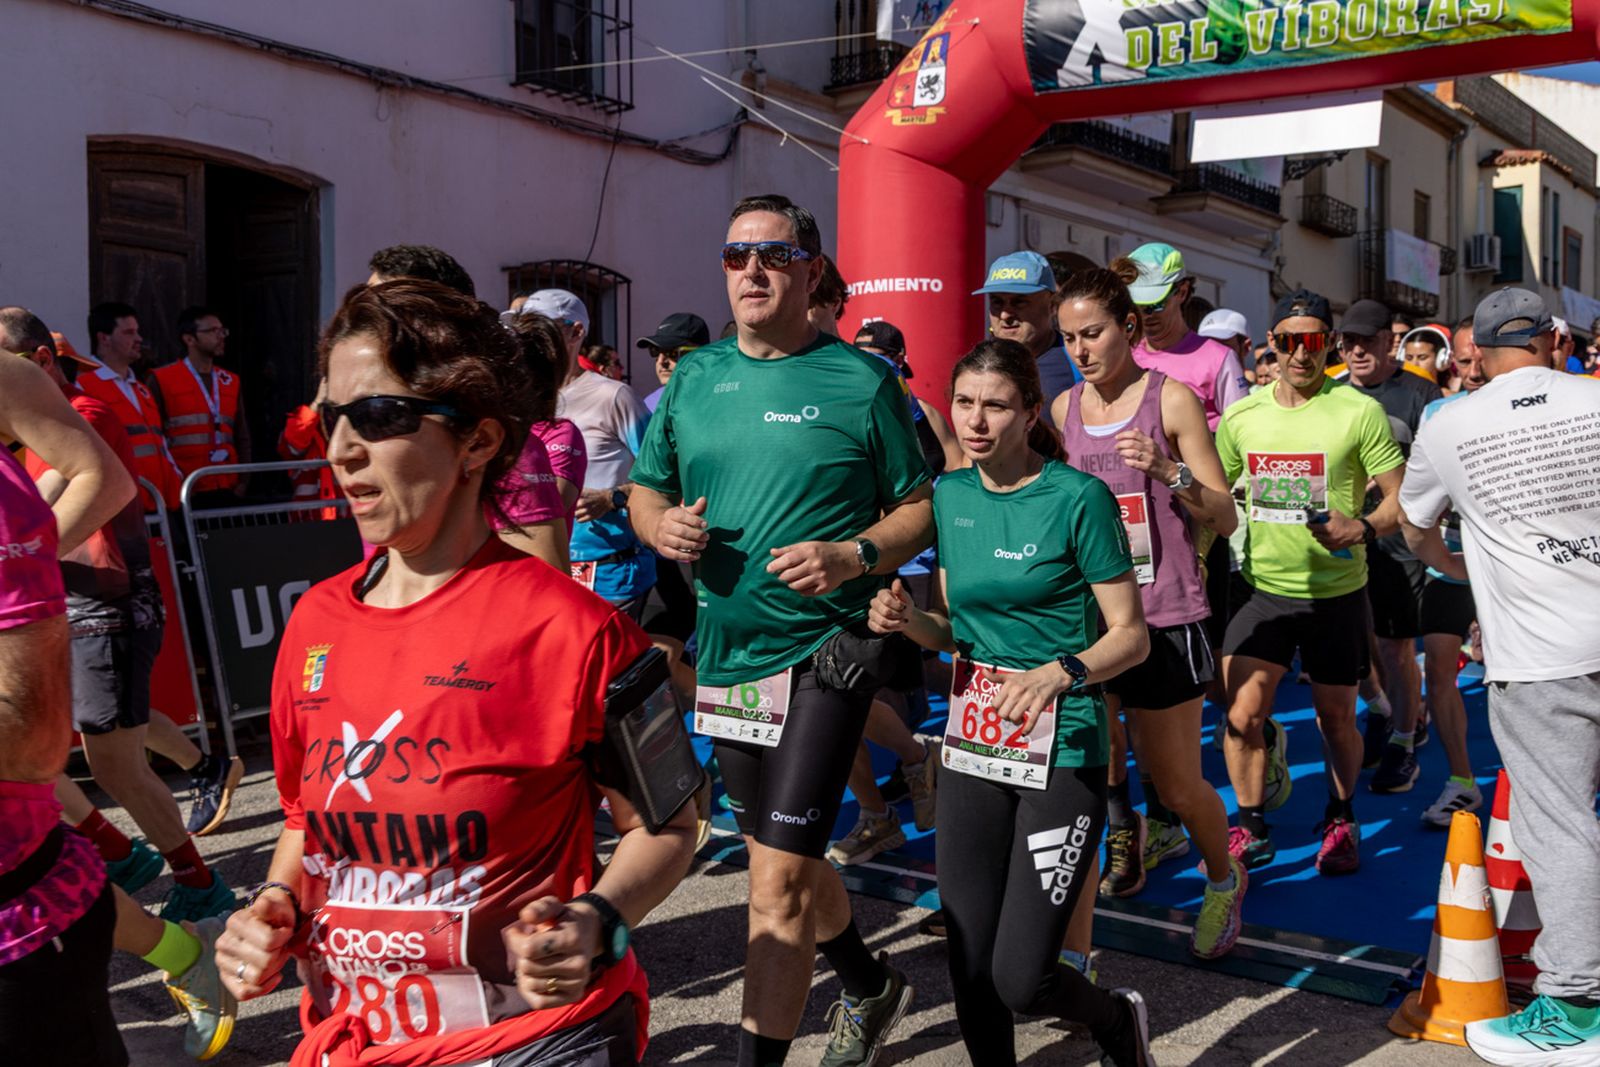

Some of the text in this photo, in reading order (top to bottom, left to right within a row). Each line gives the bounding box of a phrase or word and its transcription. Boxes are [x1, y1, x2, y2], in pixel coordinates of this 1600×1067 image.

[1123, 0, 1505, 70] DEL VÍBORAS
[990, 268, 1027, 281] HOKA
[847, 277, 943, 297] NTAMIENTO
[713, 381, 741, 394] GOBIK
[1511, 393, 1548, 410] PONY
[763, 411, 802, 423] Orona
[1464, 438, 1479, 448] THE
[1480, 432, 1505, 444] EARLY
[1531, 423, 1547, 432] THE
[1550, 417, 1573, 428] ONLY
[1574, 411, 1596, 423] RULE
[1459, 447, 1487, 462] BROKEN
[1488, 442, 1508, 453] NEW
[1509, 436, 1533, 446] YORK
[1534, 431, 1555, 442] WAS
[1556, 428, 1569, 437] TO
[1571, 422, 1593, 434] STAY
[1483, 452, 1507, 464] WHEN
[1508, 446, 1533, 457] PONY
[1534, 441, 1559, 452] FIRST
[1562, 431, 1600, 446] APPEARE
[1080, 452, 1122, 472] NEVER
[1256, 456, 1268, 469] X
[1269, 460, 1311, 471] CROSS
[1486, 459, 1524, 474] ORIGINAL
[1526, 448, 1573, 464] SNEAKERS
[1574, 443, 1600, 455] DESIG
[1514, 468, 1534, 477] NEW
[1535, 459, 1577, 473] YORKERS
[1577, 454, 1600, 465] SLIPP
[1258, 477, 1311, 501] 253
[1497, 482, 1517, 493] THEY
[1518, 472, 1565, 488] IDENTIFIED
[1527, 488, 1543, 498] THE
[1544, 482, 1574, 494] TOUGH
[1575, 478, 1595, 489] CITY
[1518, 499, 1545, 510] SINCE
[1544, 490, 1596, 505] SYMBOLIZED
[1498, 516, 1508, 525] OF
[1534, 507, 1557, 518] THAT
[994, 548, 1023, 560] Orona
[423, 675, 497, 691] TEAMERGY
[963, 688, 994, 706] PANTA
[961, 701, 1029, 749] 682
[303, 736, 451, 784] CROSS
[771, 810, 807, 826] Orona
[303, 810, 489, 868] ANTANO
[1050, 814, 1091, 906] adidas
[329, 927, 426, 960] CROSS
